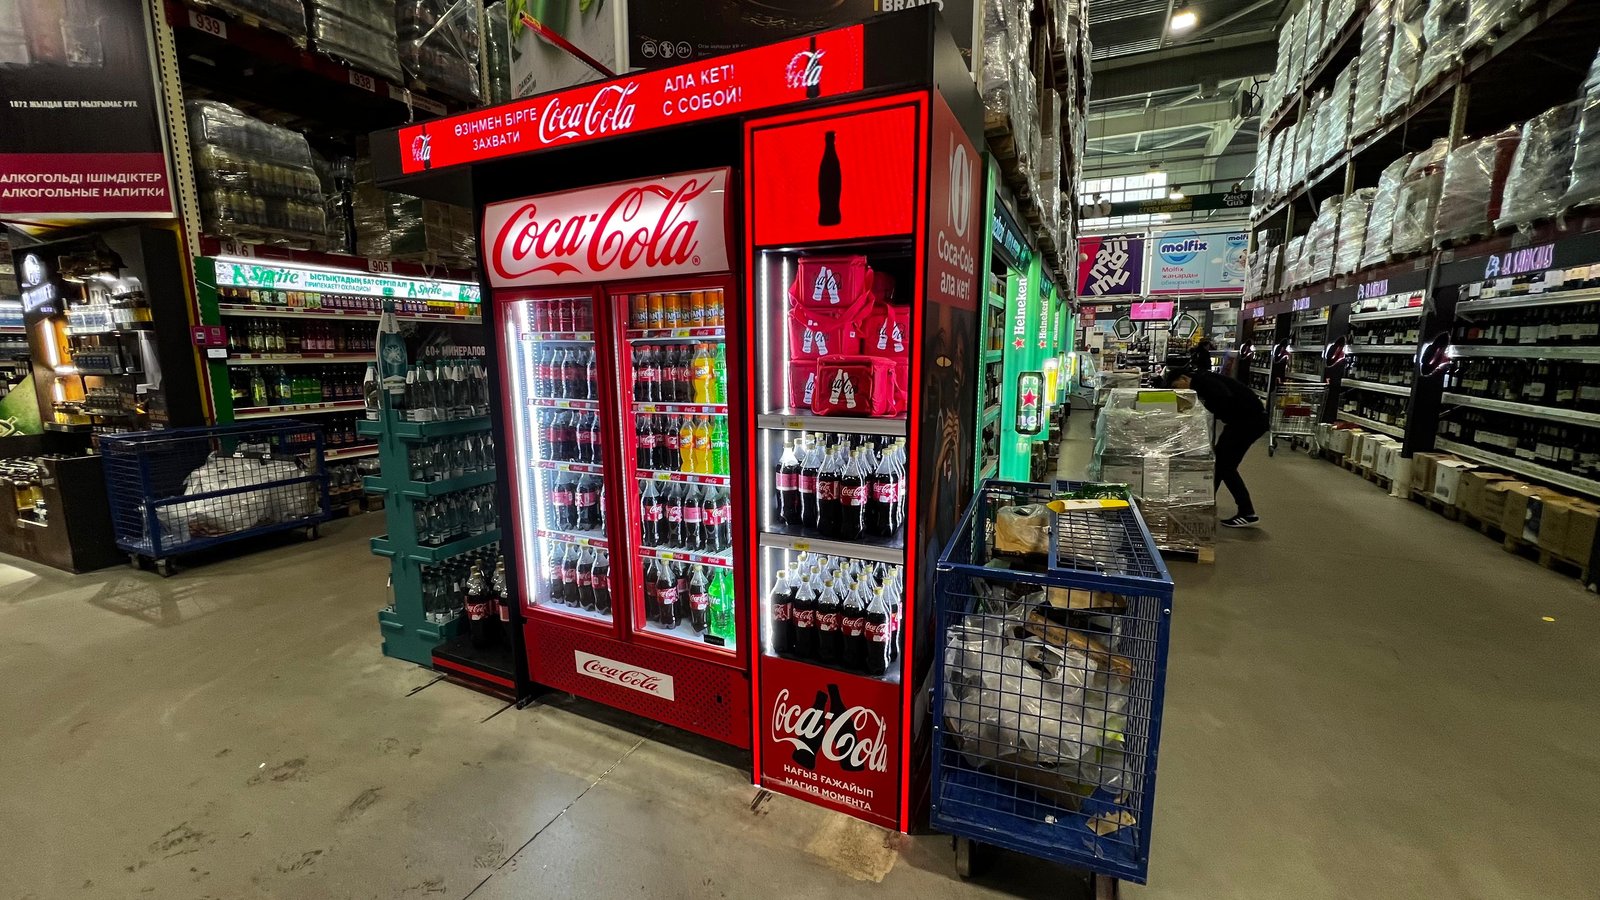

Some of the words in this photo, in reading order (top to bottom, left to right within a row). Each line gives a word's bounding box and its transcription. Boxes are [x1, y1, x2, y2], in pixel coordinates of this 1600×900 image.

[197, 14, 221, 34] 939
[678, 45, 690, 54] 21+
[353, 72, 371, 90] 938
[664, 73, 696, 93] АЛА
[700, 64, 735, 85] КЕТ!
[538, 81, 640, 144] Coca-Cola
[662, 100, 674, 116] С
[677, 86, 743, 114] СОБОЙ!
[454, 116, 503, 137] ӨЗІҢМЕН
[505, 107, 538, 126] БІРГЕ
[472, 131, 521, 151] ЗАХВАТИ
[0, 173, 83, 184] АЛКОГОЛЬДІ
[86, 173, 162, 184] ІШІМДІКТЕР
[2, 188, 100, 198] АЛКОГОЛЬНЫЕ
[103, 187, 165, 197] НАПИТКИ
[492, 175, 716, 280] Coca-Cola
[937, 230, 974, 276] Coca-Cola
[1160, 240, 1208, 254] molfix
[249, 266, 299, 285] Sprite
[372, 260, 389, 272] 905
[417, 284, 442, 296] Sprite
[940, 271, 956, 296] ала
[956, 278, 970, 301] кет!
[1014, 278, 1028, 336] Heineken
[1039, 301, 1049, 339] Heineken
[442, 346, 486, 356] МИНЕРАЛОВ
[583, 659, 663, 691] Coca-Cola
[771, 688, 888, 773] Coca-Cola
[783, 763, 818, 781] НАҒЫЗ
[820, 774, 874, 799] ҒАЖАЙЫП
[785, 777, 819, 794] МАГИЯ
[821, 788, 872, 811] МОМЕНТА
